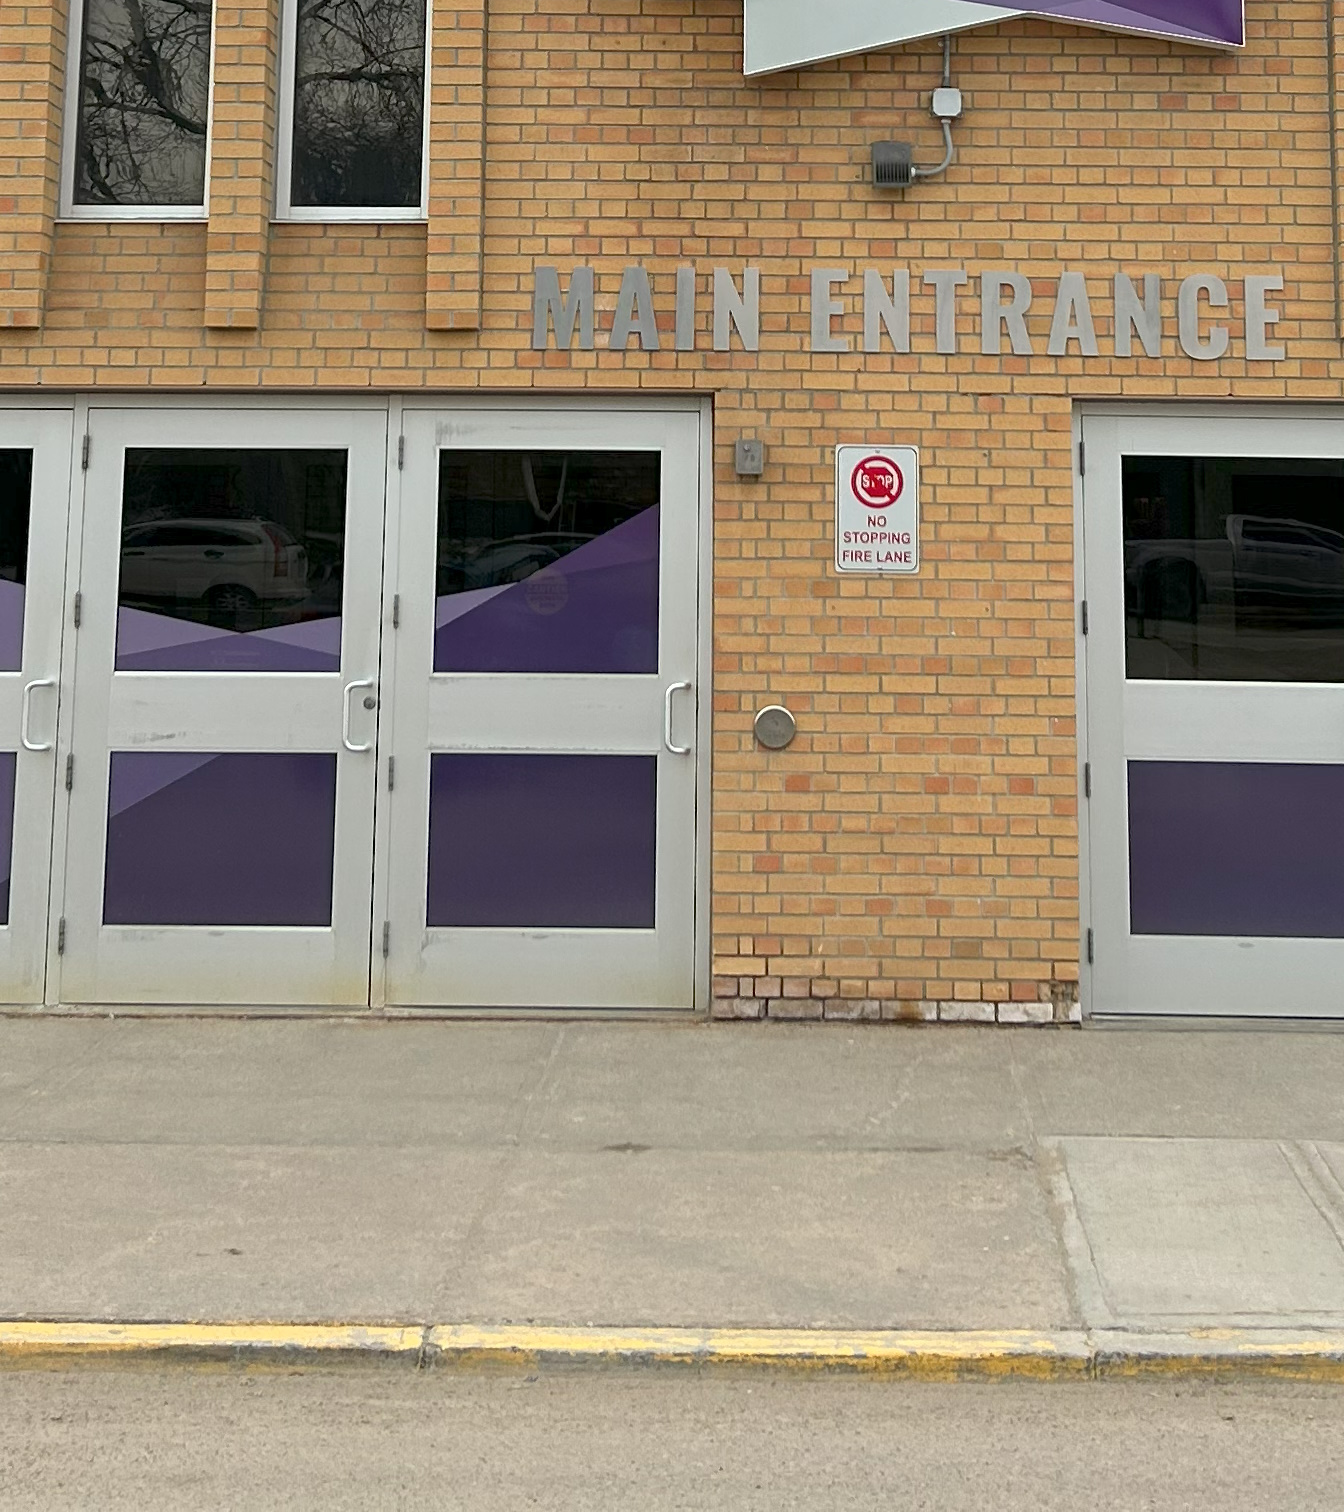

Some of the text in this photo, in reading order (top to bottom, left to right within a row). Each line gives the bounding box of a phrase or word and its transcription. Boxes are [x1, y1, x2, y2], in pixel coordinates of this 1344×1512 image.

[532, 266, 1285, 360] MAIN ENTRANCE
[867, 515, 887, 528] NO
[843, 531, 911, 544] STOPPING
[842, 550, 912, 563] FIRE LANE
